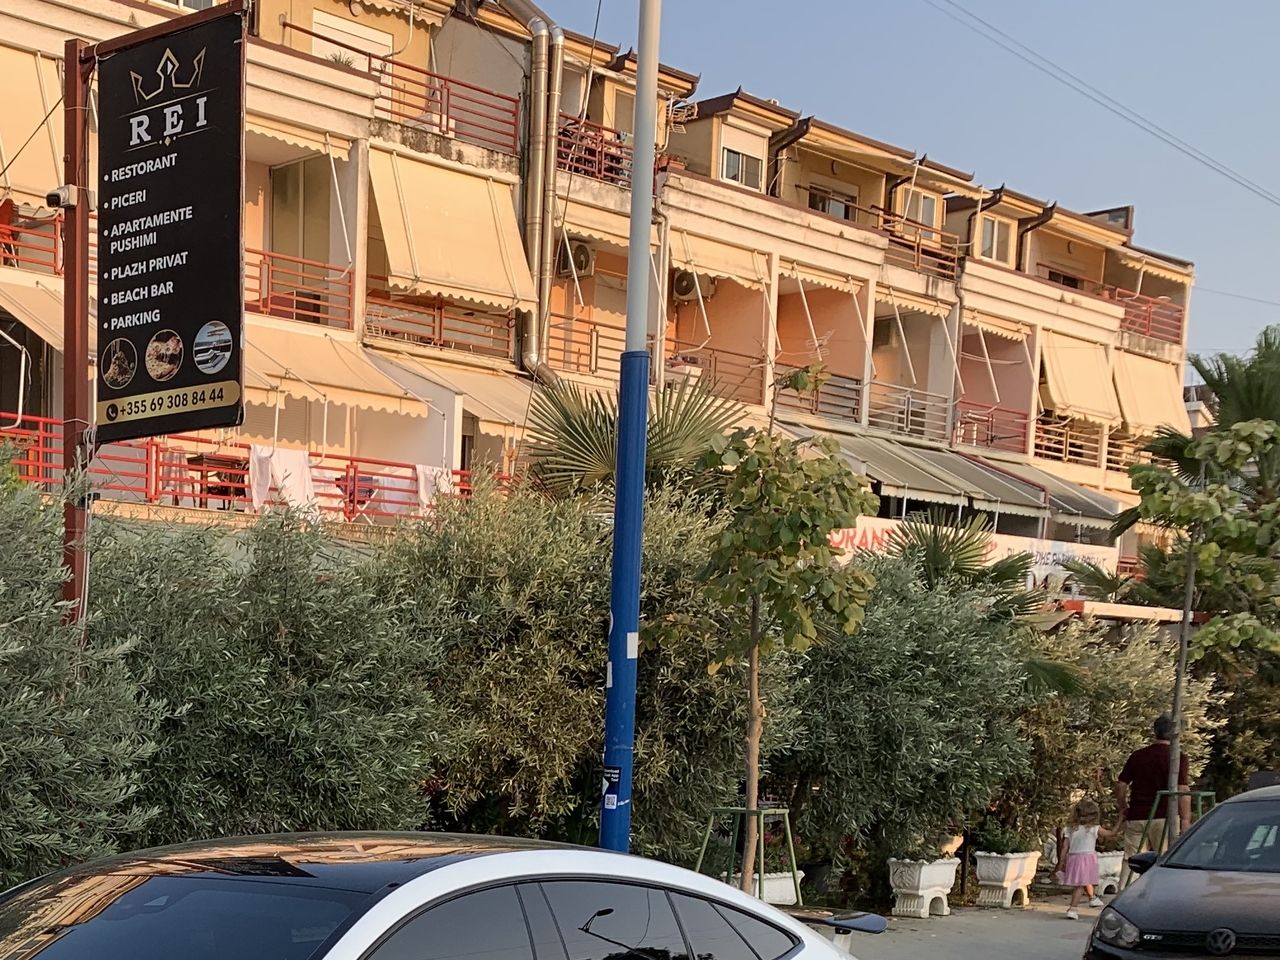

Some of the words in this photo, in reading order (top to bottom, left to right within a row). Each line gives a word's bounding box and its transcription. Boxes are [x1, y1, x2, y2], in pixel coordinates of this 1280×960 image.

[129, 96, 208, 146] REI
[111, 153, 178, 183] RESTORANT
[111, 190, 147, 210] PICERI
[110, 206, 193, 237] APARTAMENTE
[110, 232, 157, 255] PUSHIMI
[111, 262, 147, 281] PLAZH
[149, 251, 189, 273] PRIVAT
[111, 286, 148, 306] BEACH
[151, 281, 174, 300] BAR
[110, 309, 161, 330] PARKING
[119, 399, 147, 417] +355
[150, 397, 164, 413] 69
[166, 393, 189, 410] 308
[191, 391, 206, 407] 84
[209, 387, 224, 404] 44
